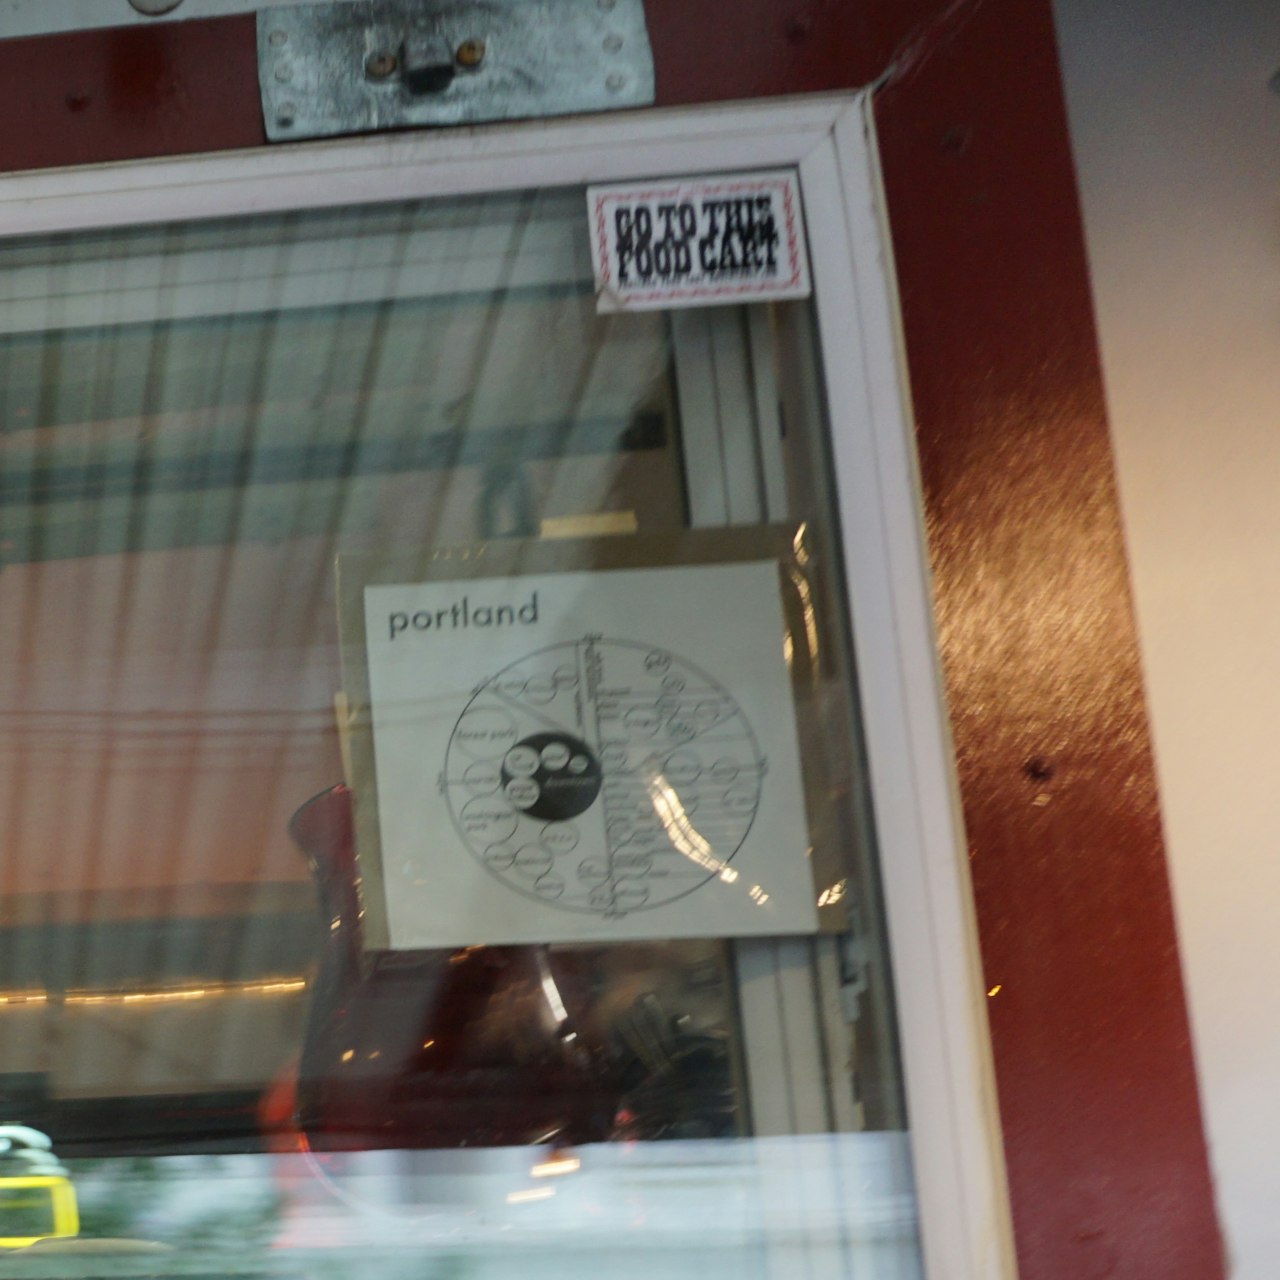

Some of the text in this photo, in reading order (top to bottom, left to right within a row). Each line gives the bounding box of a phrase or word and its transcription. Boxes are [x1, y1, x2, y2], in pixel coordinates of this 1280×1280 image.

[616, 240, 692, 280] FOOD
[699, 230, 778, 272] CART
[389, 592, 539, 639] portland
